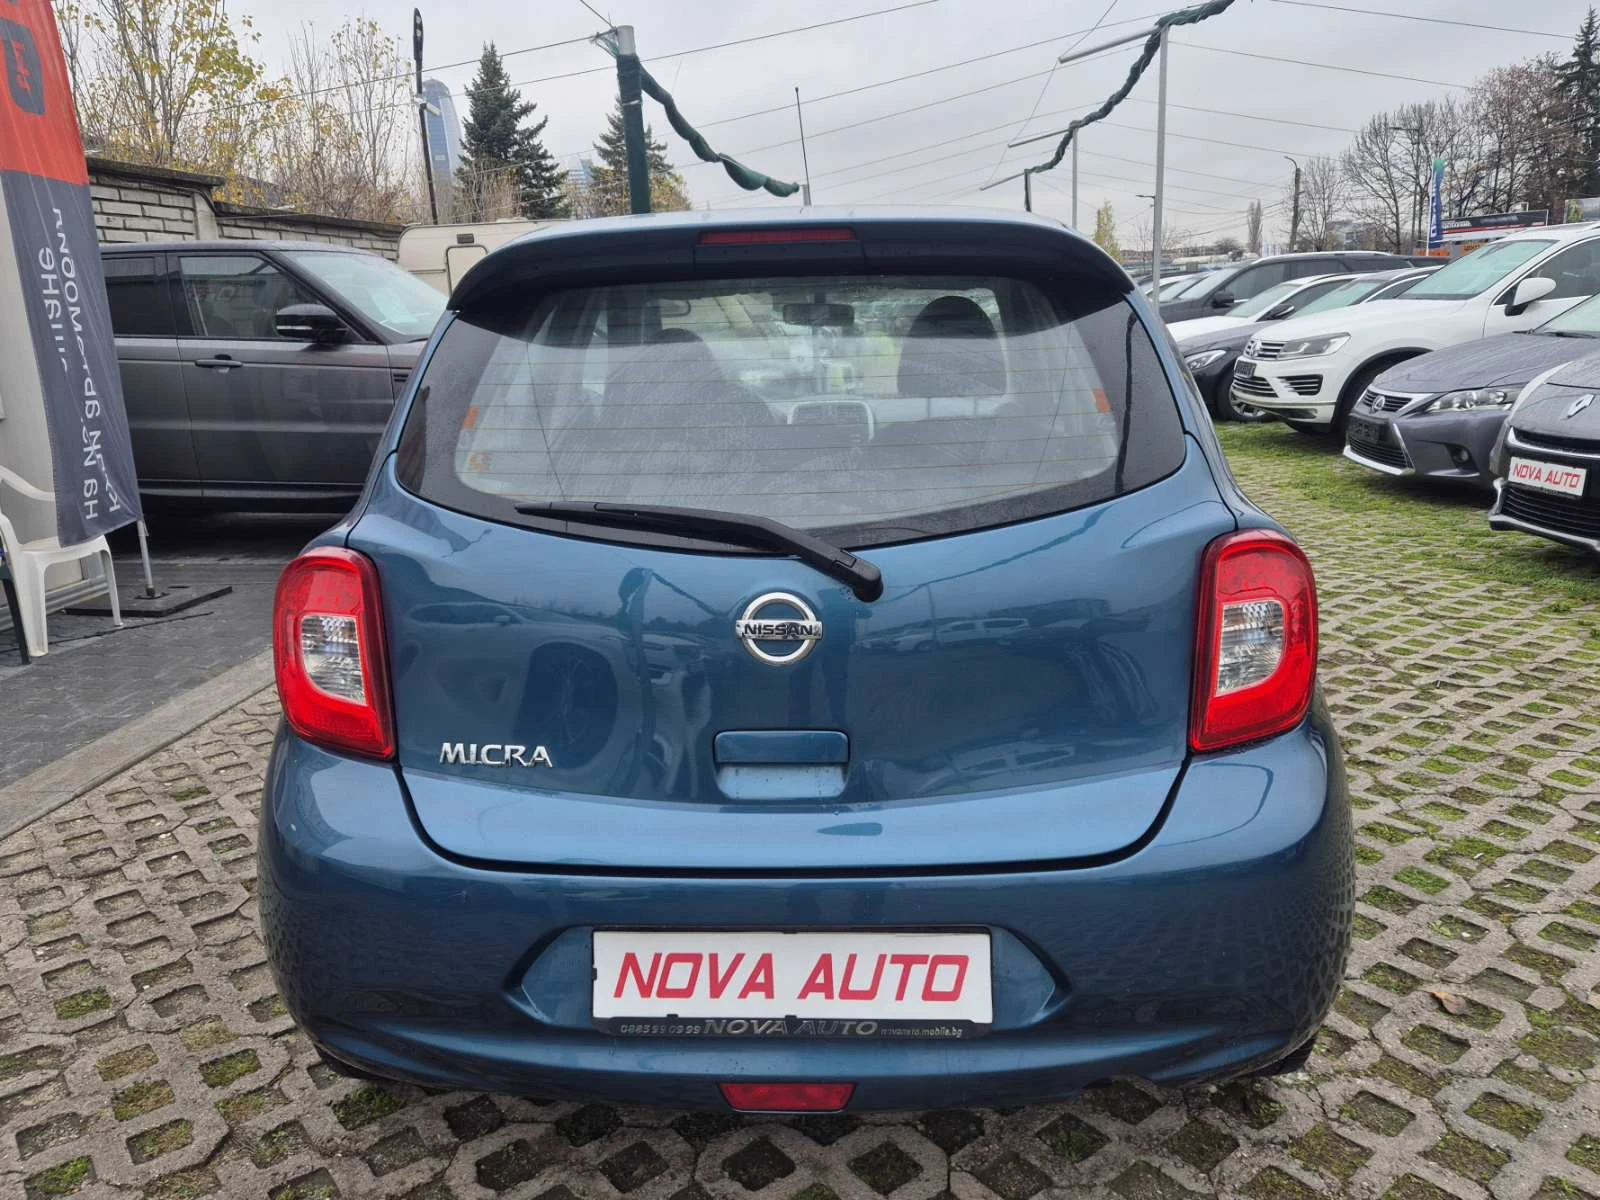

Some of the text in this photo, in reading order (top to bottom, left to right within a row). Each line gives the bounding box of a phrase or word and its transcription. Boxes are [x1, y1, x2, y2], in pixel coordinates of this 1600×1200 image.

[1513, 463, 1581, 488] NOVA AUTO
[744, 623, 813, 636] NISSAN
[440, 742, 553, 768] MICRA
[613, 952, 970, 1002] NOVA AUTO
[703, 1019, 788, 1035] NOVA
[794, 1020, 879, 1035] AUTO
